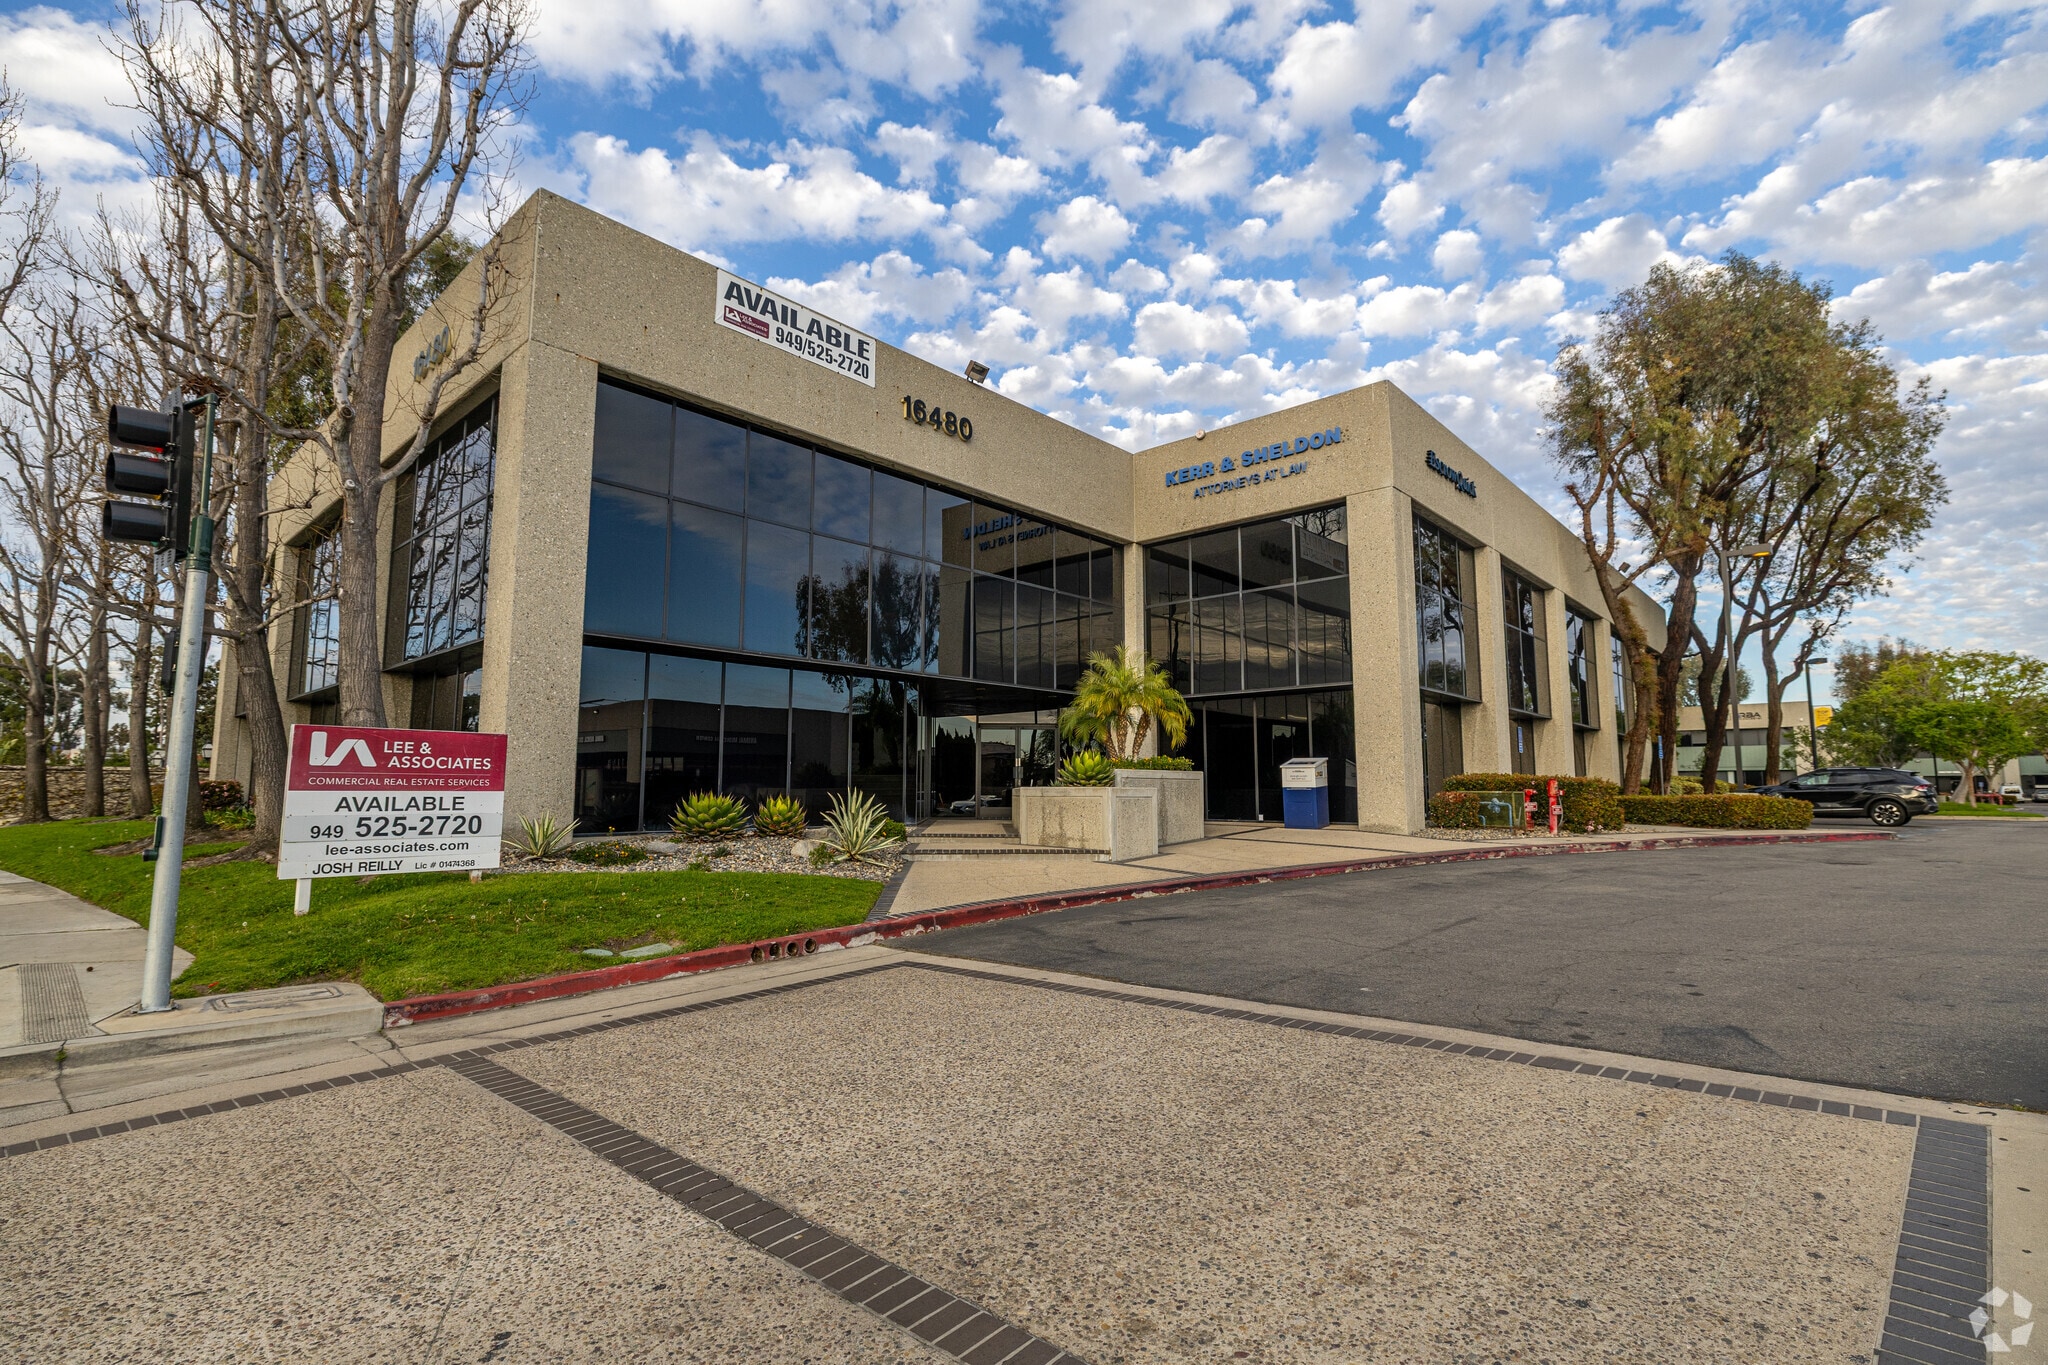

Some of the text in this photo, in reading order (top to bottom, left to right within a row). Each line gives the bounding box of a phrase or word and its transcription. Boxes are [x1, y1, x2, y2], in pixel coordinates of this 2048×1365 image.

[724, 281, 871, 361] AVAILABLE
[775, 327, 869, 380] 949/525-2720
[901, 395, 973, 442] 16480
[1165, 426, 1343, 488] KERR & SHELDON
[1193, 461, 1308, 499] ATTORNEYS AT LAW
[383, 741, 432, 755] LEE &
[387, 756, 492, 770] ASSOCIATES
[308, 777, 490, 787] COMMERCIAL REAL ESTATE SERVICES
[334, 796, 466, 813] AVAILABLE
[310, 815, 482, 839] 949 525-2720
[325, 841, 469, 855] lee-associates.com
[312, 862, 353, 875] JOSH
[358, 860, 403, 873] REILLY
[415, 862, 428, 870] Lic
